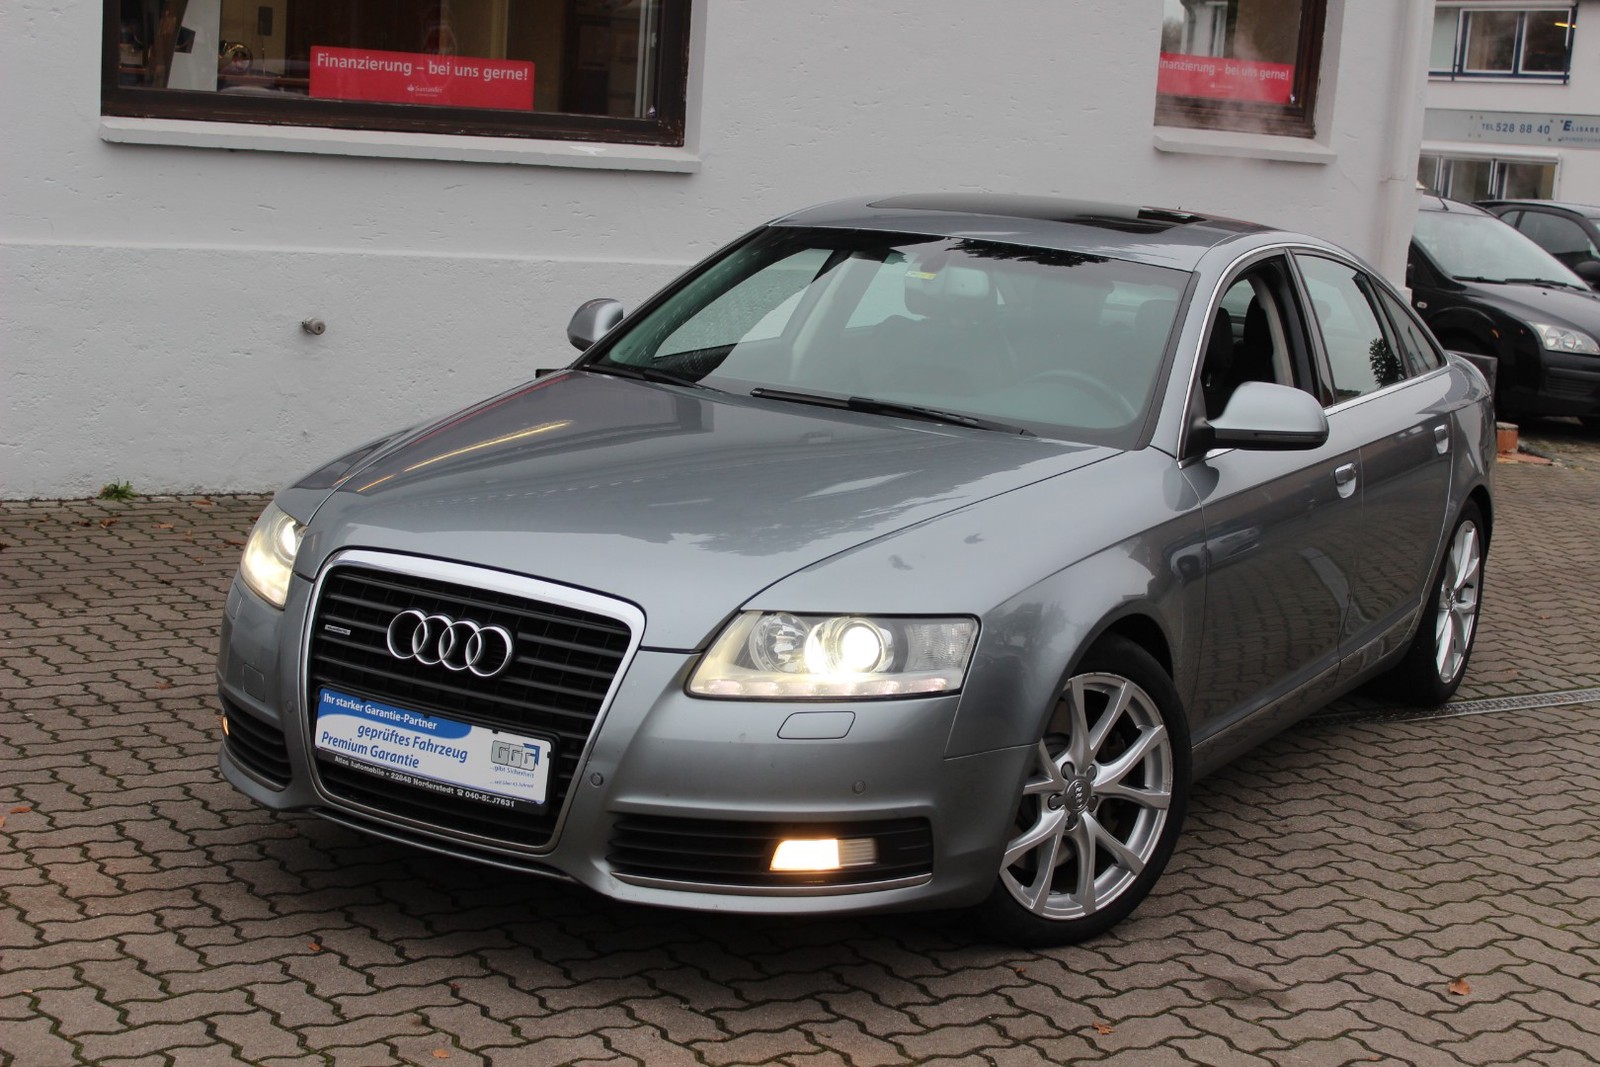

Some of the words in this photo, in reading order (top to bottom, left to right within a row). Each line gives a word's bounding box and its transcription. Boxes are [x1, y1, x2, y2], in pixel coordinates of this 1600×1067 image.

[317, 53, 412, 76] Finanzierung
[429, 61, 450, 75] bei
[454, 66, 479, 77] uns
[483, 67, 528, 81] gerne!
[1225, 64, 1240, 75] bei
[1242, 66, 1257, 77] uns
[1260, 69, 1289, 80] gerne!
[1495, 122, 1515, 133] 528
[1519, 123, 1532, 134] 88
[1537, 125, 1550, 134] 40
[324, 693, 335, 704] Ihr
[336, 697, 364, 712] starker
[365, 704, 438, 730] Garantie-Partner
[321, 731, 367, 755] Premium
[370, 745, 420, 768] Garantie
[357, 724, 410, 747] geprüftes
[412, 736, 468, 763] Fahrzeug
[350, 760, 385, 776] Automobile
[413, 777, 454, 794] Norderstedt
